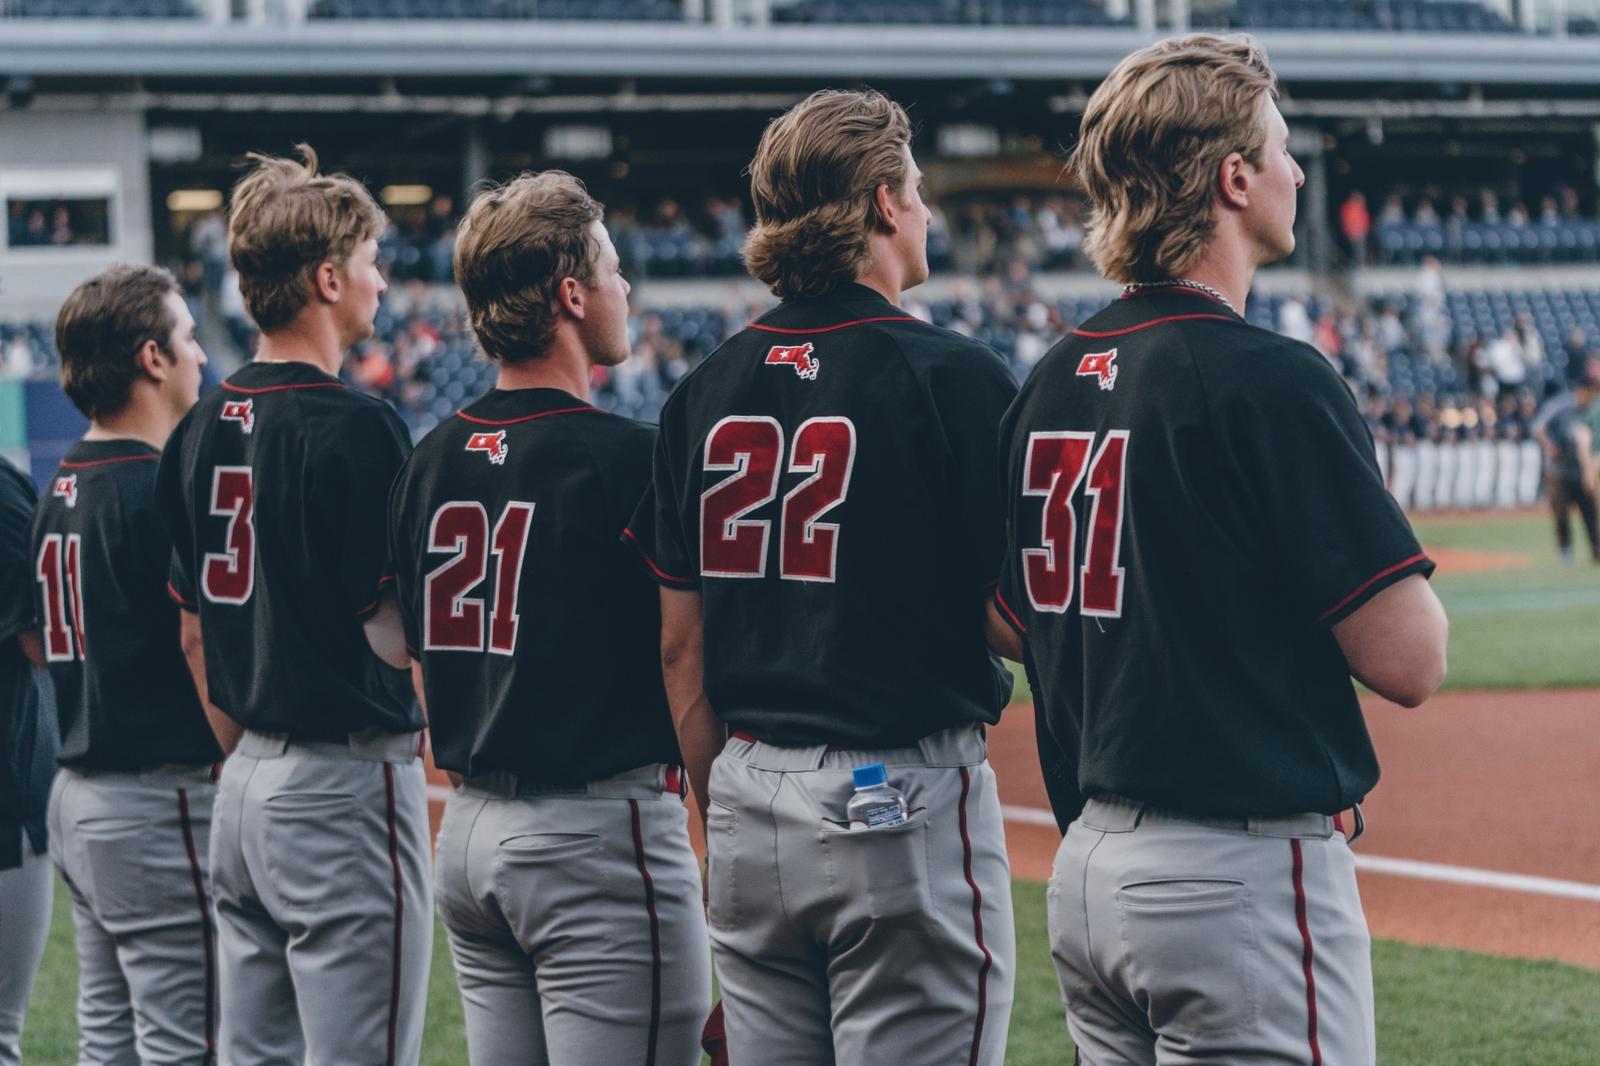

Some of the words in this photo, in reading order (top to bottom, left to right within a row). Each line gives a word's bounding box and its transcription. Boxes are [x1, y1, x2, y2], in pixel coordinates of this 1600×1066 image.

[202, 466, 255, 605] 3
[423, 501, 535, 655] 21
[700, 415, 857, 583] 22
[1022, 429, 1131, 618] 31
